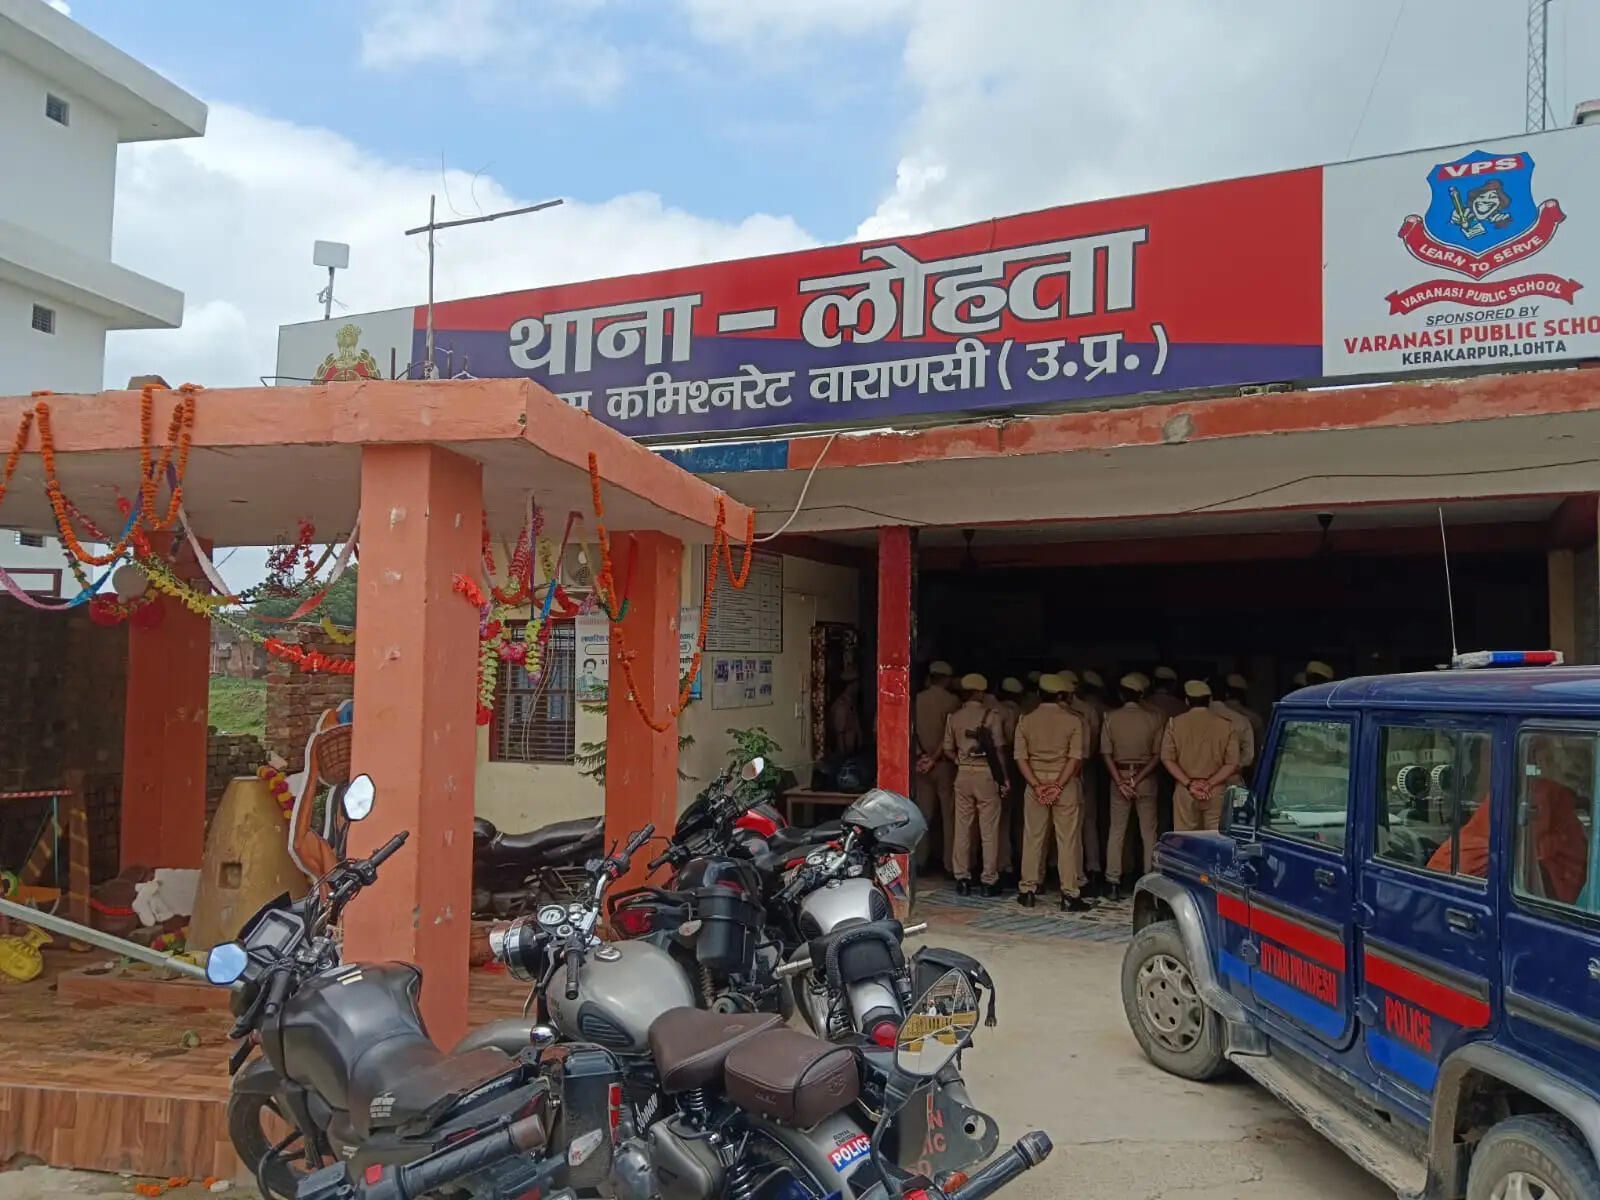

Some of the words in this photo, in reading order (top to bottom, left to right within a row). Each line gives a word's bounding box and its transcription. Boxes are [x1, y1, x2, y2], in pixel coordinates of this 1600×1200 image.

[1444, 157, 1518, 177] VPS
[1419, 243, 1467, 267] LEARN
[1469, 261, 1490, 273] TO
[1492, 235, 1544, 263] SERVE
[508, 293, 702, 377] थाना
[798, 226, 1147, 350] लोहता
[1401, 286, 1464, 309] VARANASI
[1465, 289, 1508, 303] PUBLIC
[1508, 280, 1562, 296] SCHOOL
[1343, 327, 1454, 355] VARANASI
[1460, 320, 1538, 346] PUBLIC
[1543, 315, 1600, 338] SCHO
[1425, 307, 1515, 326] SPONSORED
[1518, 305, 1540, 318] BY
[605, 364, 796, 421] कमिश्नरेट
[808, 336, 991, 404] वाराणसी
[1290, 954, 1337, 1008] PRADESH
[1385, 996, 1431, 1053] POLICE
